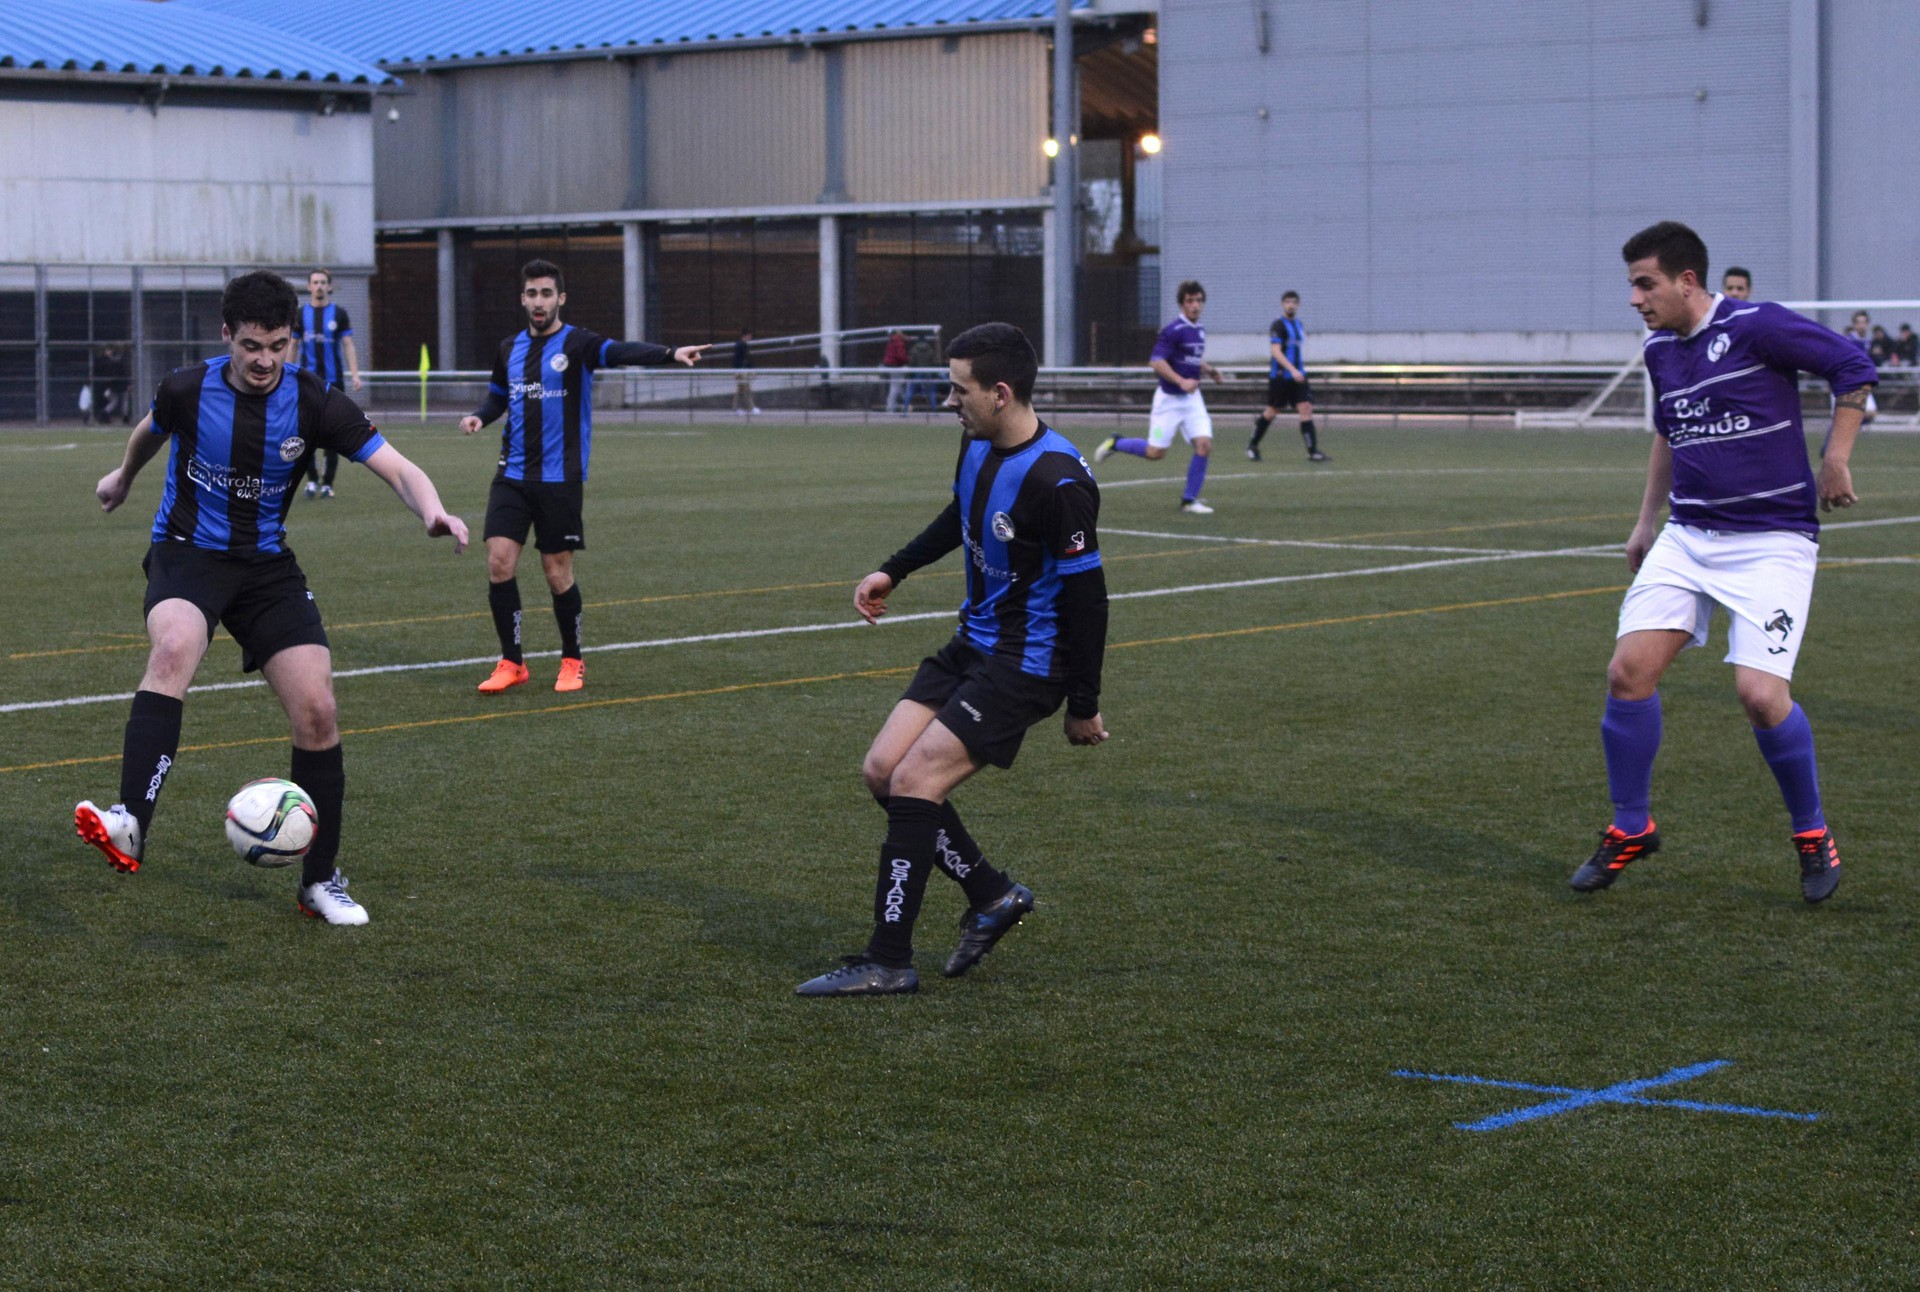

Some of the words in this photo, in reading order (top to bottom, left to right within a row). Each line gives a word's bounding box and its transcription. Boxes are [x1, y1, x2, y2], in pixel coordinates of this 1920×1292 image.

[1674, 397, 1710, 419] Bar
[213, 473, 260, 488] Kirola
[883, 858, 912, 923] OSTADAR
